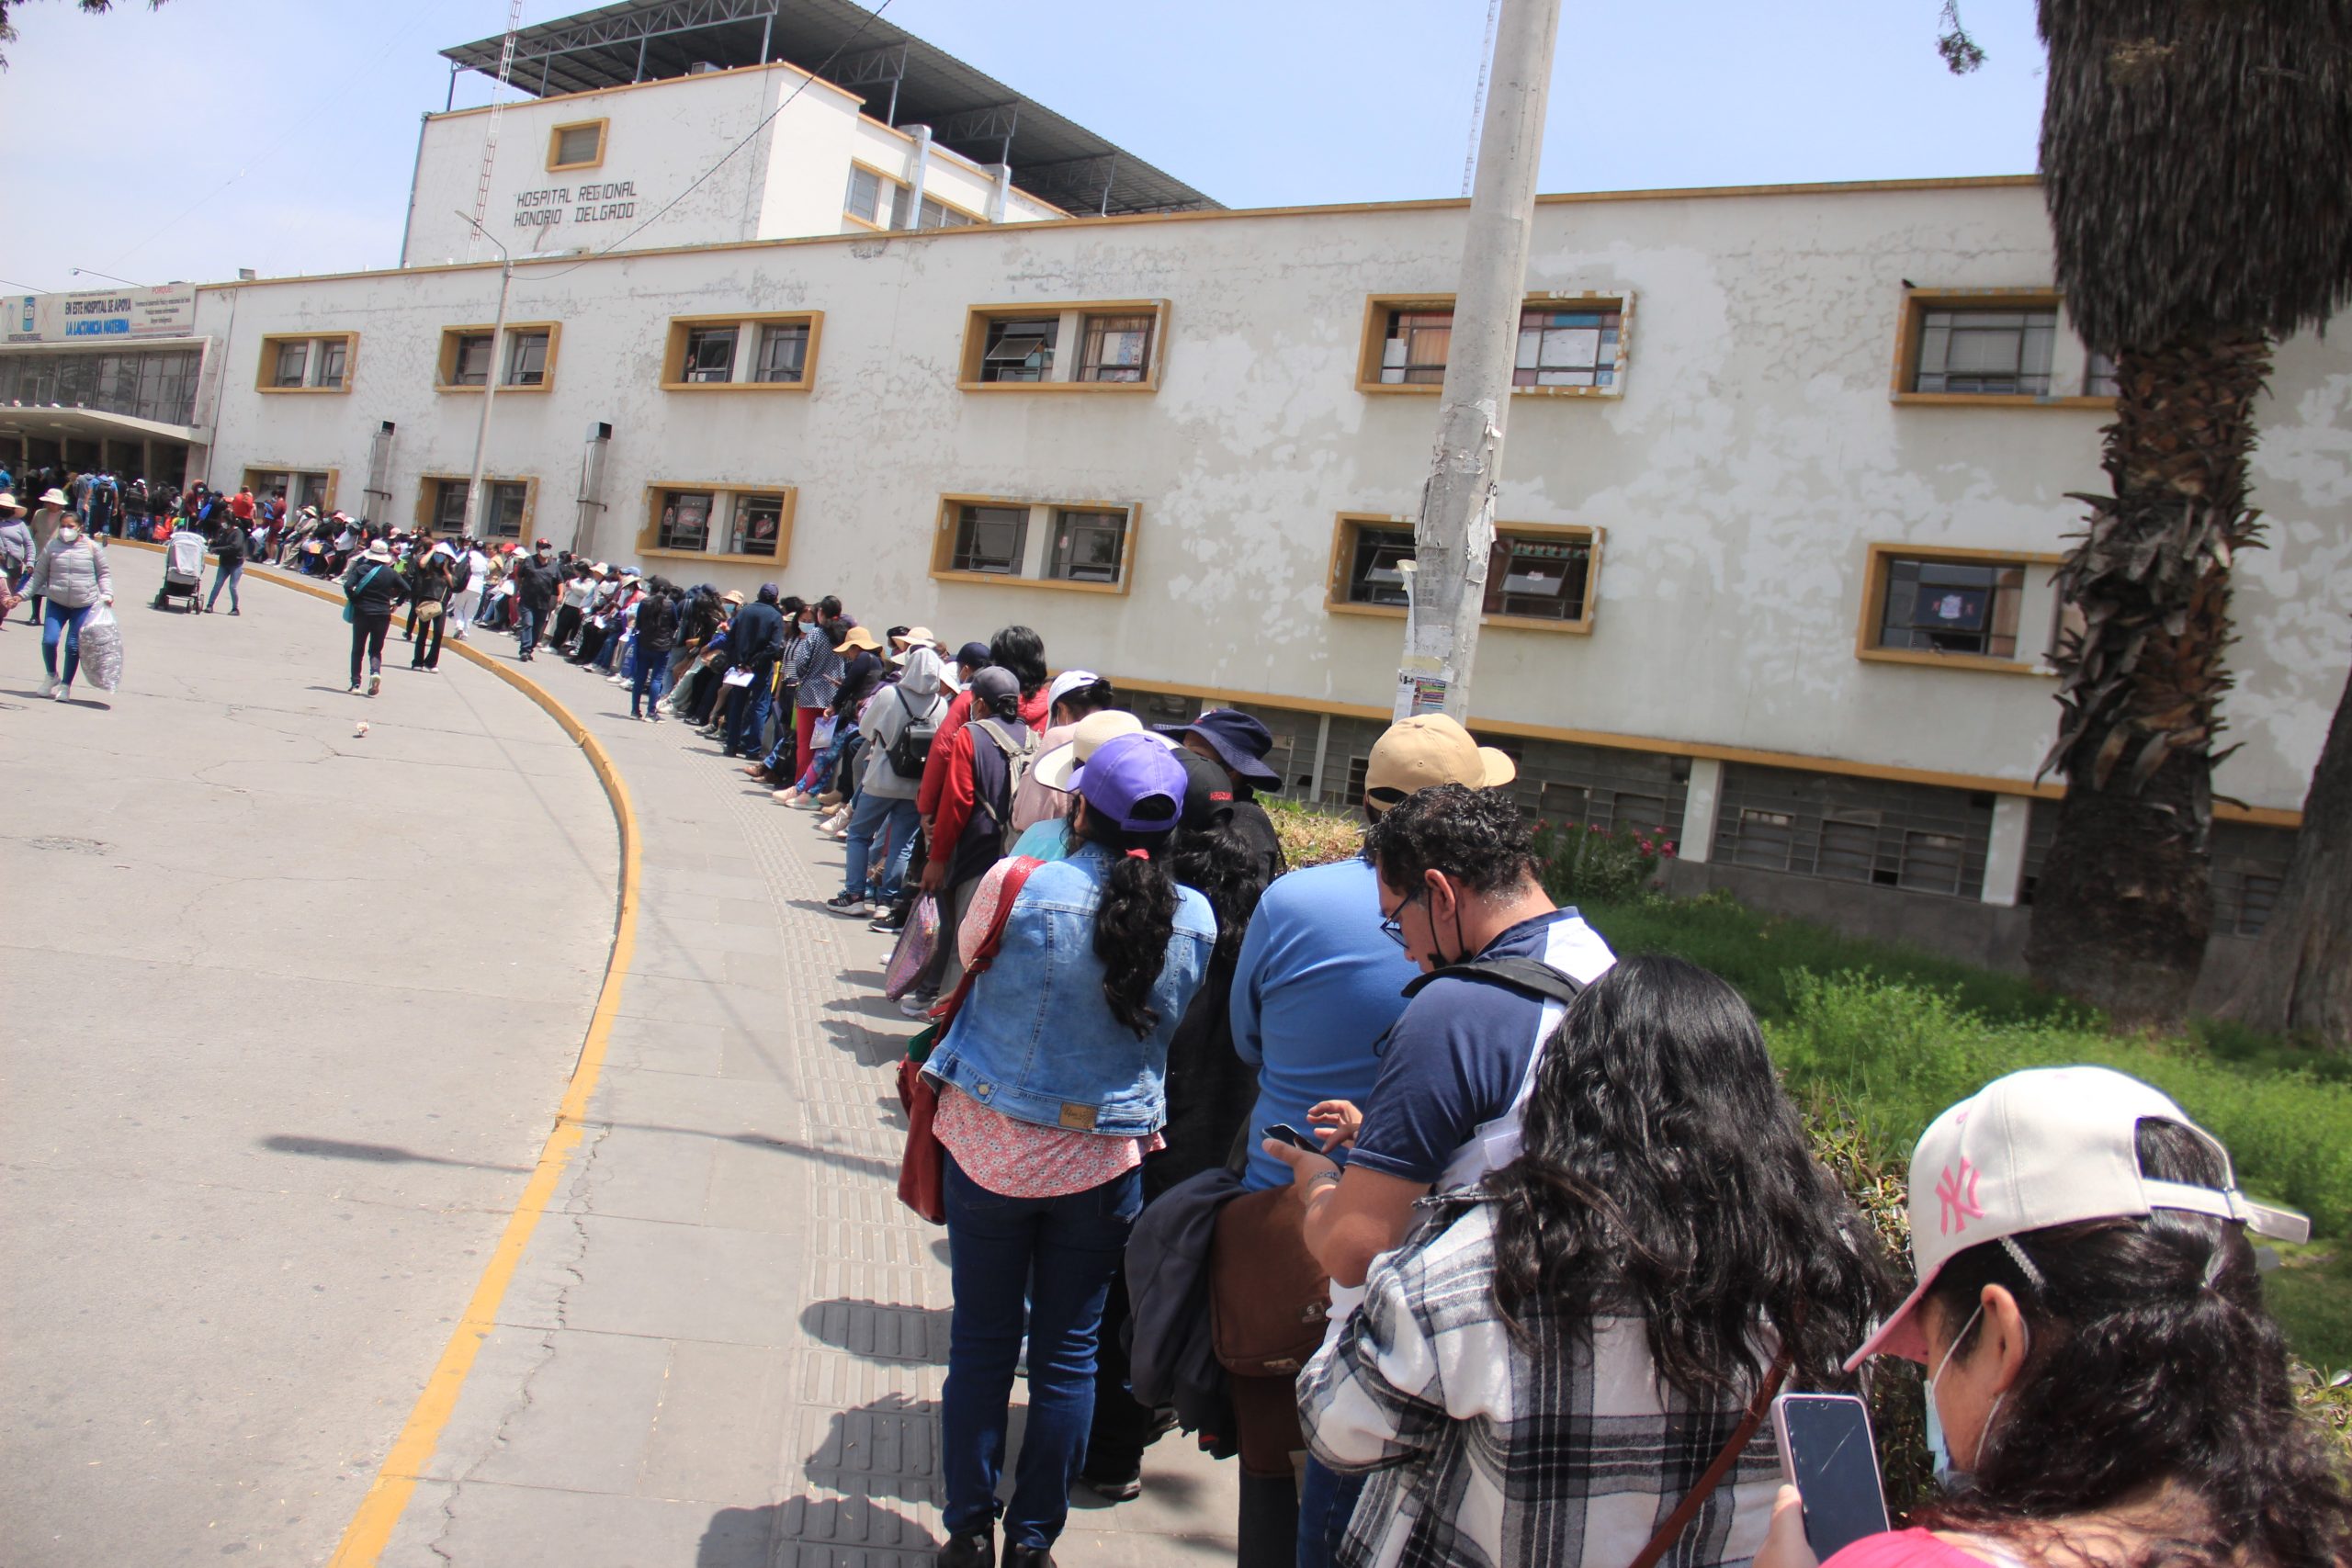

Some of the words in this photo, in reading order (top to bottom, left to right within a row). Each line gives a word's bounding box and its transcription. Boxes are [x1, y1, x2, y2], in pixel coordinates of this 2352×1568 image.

[516, 188, 571, 208] HOSPITAL
[578, 181, 637, 202] REGIONAL
[514, 209, 562, 227] HONORIO
[574, 202, 635, 222] DELGADO
[65, 301, 72, 315] EN
[73, 300, 83, 315] ESTE
[84, 299, 107, 314] HOSPITAL
[107, 299, 113, 312] SE
[114, 298, 131, 312] APOYA
[65, 321, 73, 336] LA
[74, 320, 102, 336] LACTANCIA
[103, 318, 130, 334] MATERNA
[1935, 1156, 1984, 1236] NY
